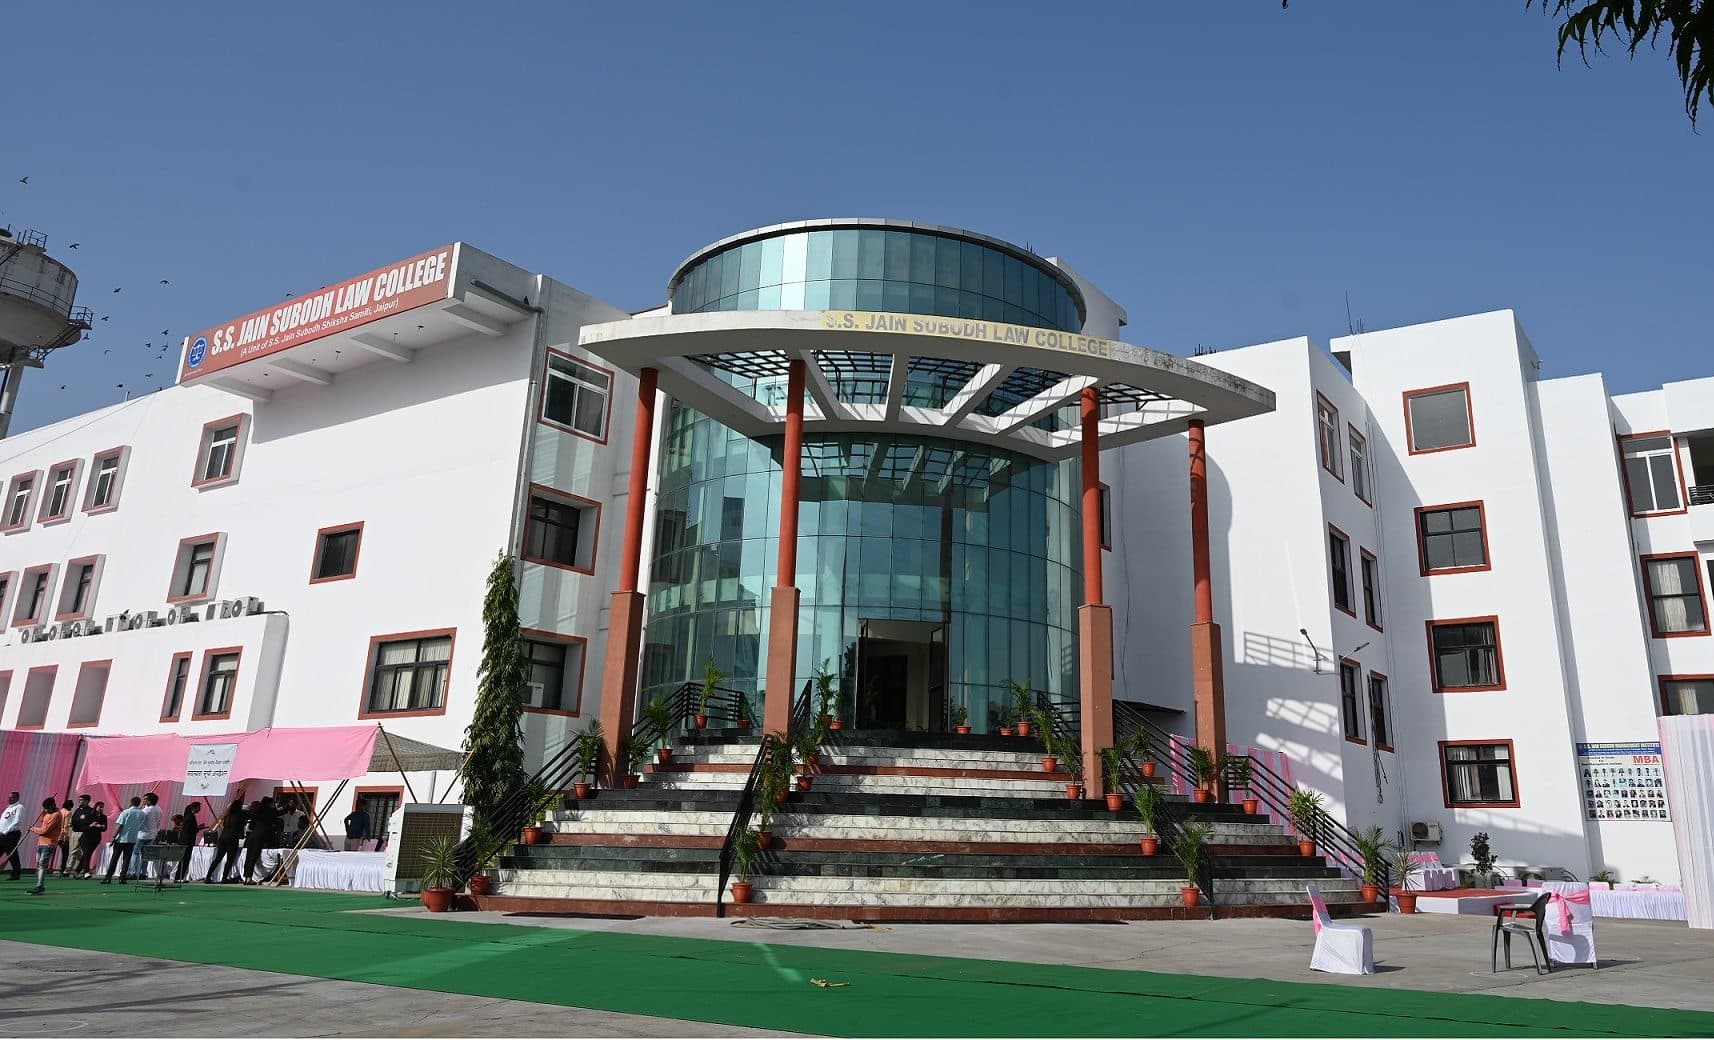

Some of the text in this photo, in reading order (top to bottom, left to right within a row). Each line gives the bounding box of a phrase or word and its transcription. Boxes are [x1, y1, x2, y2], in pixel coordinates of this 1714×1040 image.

[211, 252, 448, 355] S.S. JAIN SUBODH LAW COLLEGE
[248, 344, 260, 354] Unit
[261, 341, 268, 350] of
[268, 337, 281, 347] S.S.
[281, 332, 295, 343] Jain
[296, 322, 320, 338] Subodh
[321, 315, 348, 330] Shiksha
[373, 297, 399, 313] Jaipur)
[826, 312, 1108, 356] S.S. JAIN SUBODH LAW COLLEGE
